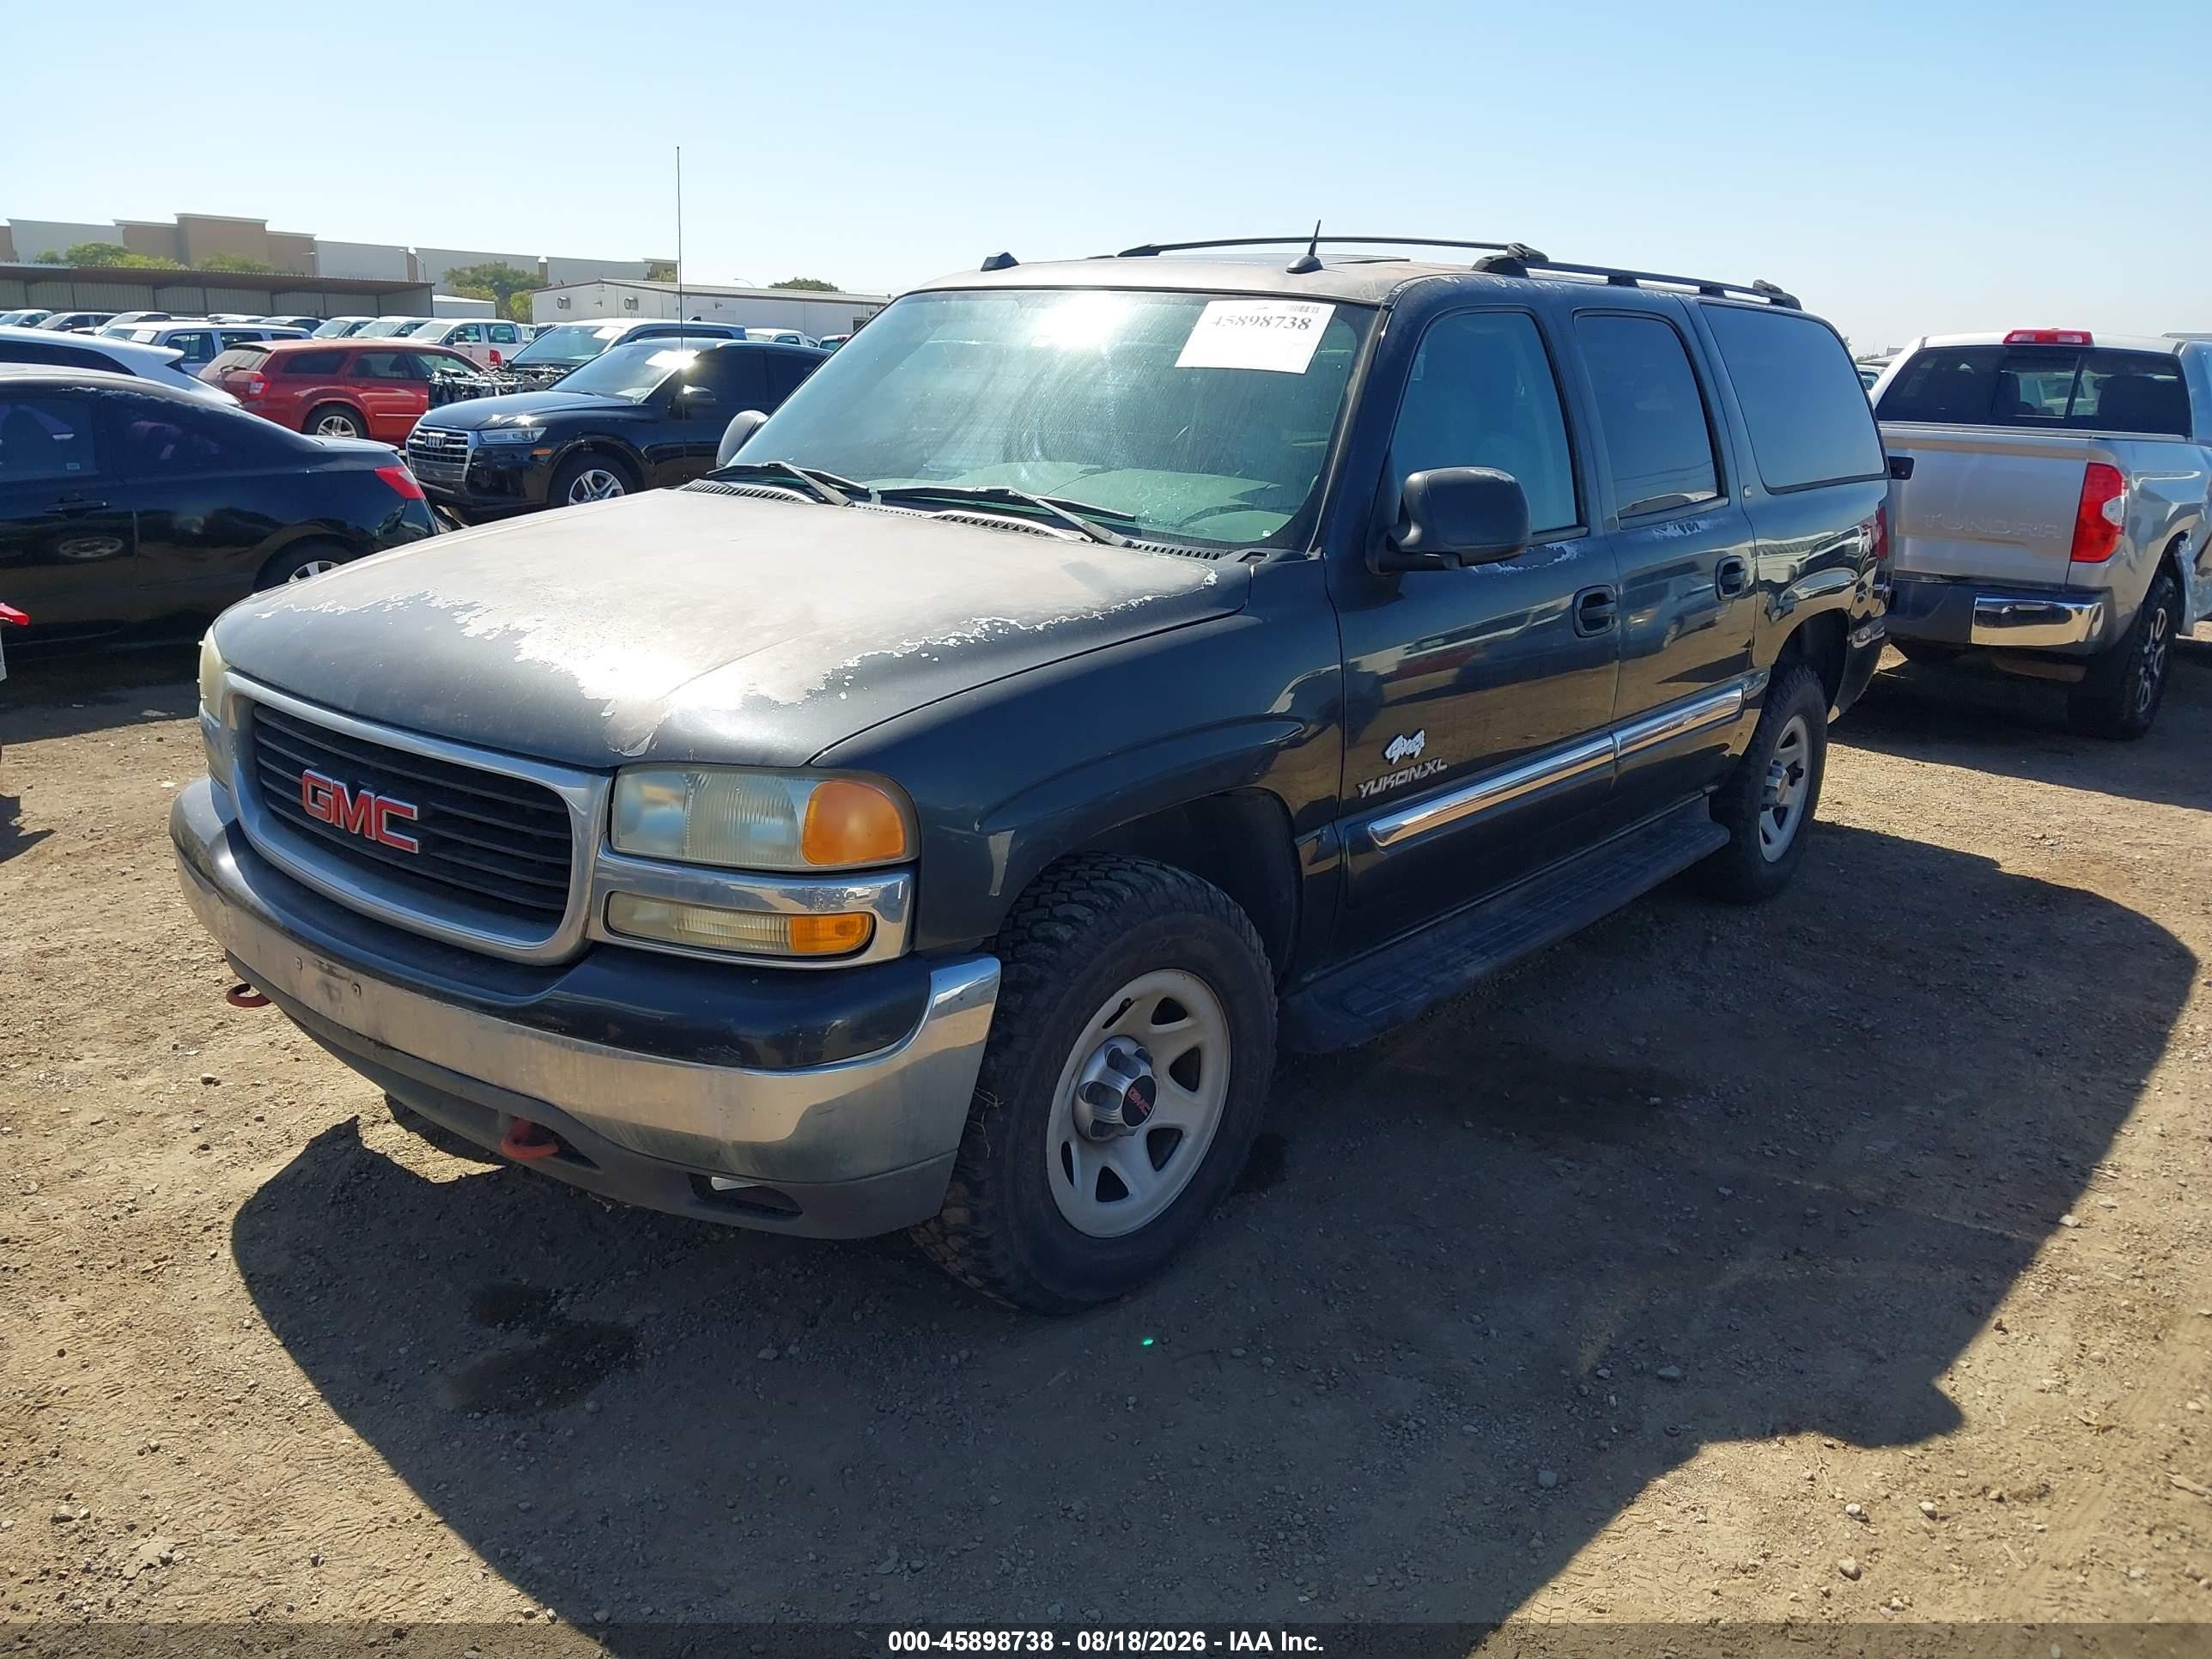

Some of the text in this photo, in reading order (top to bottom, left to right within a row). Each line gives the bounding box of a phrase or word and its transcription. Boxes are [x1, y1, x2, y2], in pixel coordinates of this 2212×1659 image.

[1358, 758, 1449, 799] YUKON XL
[302, 769, 419, 854] GMC
[1127, 1086, 1152, 1116] GMC
